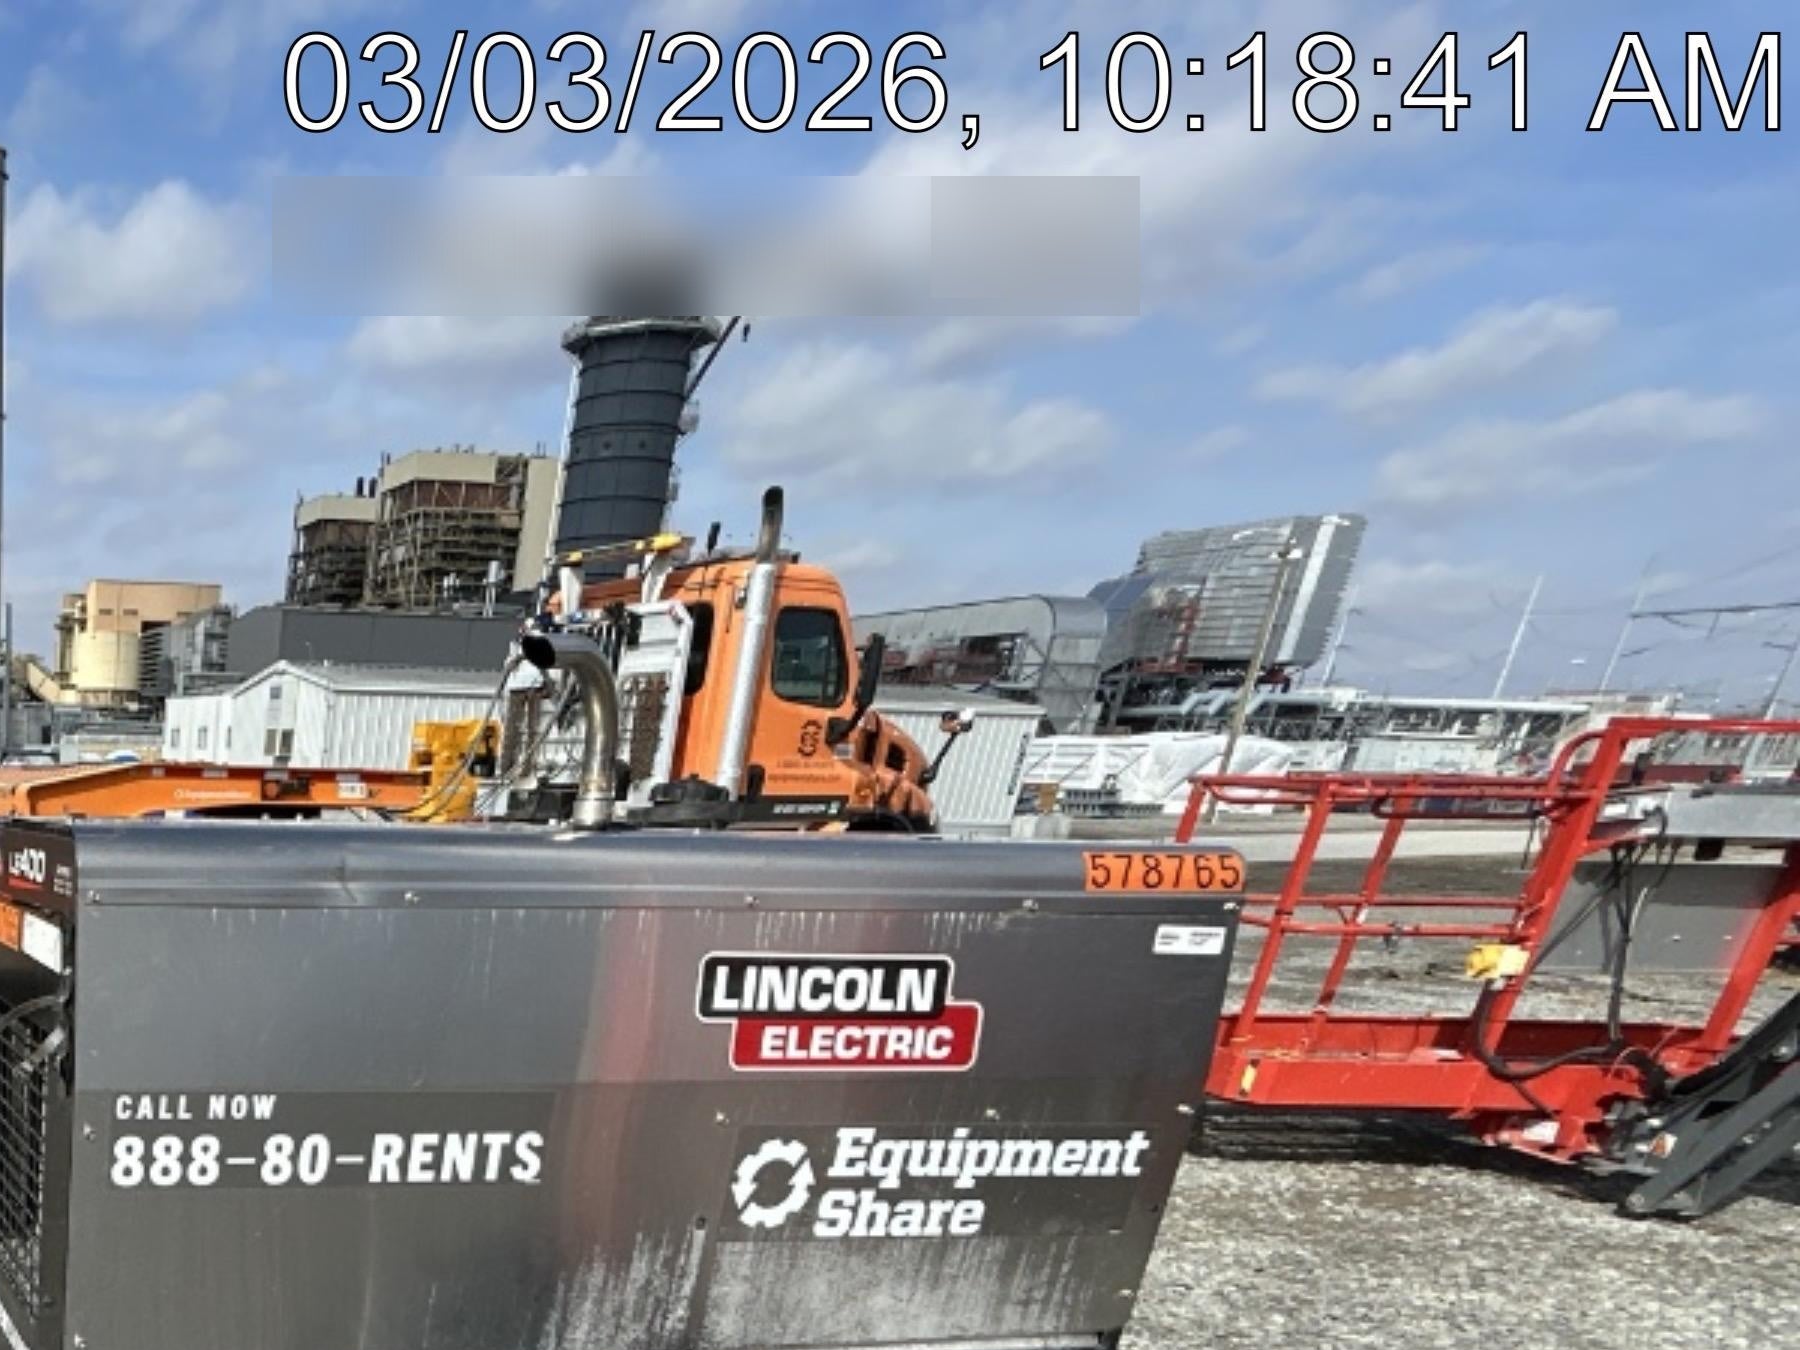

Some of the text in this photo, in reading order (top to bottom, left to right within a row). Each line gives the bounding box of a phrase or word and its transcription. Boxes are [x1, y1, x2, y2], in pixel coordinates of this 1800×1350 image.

[1090, 854, 1240, 889] 578765
[711, 965, 937, 1012] LINCOLN
[760, 1026, 954, 1060] ELECTRIC
[115, 1094, 277, 1120] CALL NOW
[110, 1132, 544, 1187] 888-80-RENTS
[827, 1126, 1150, 1190] Equipment
[812, 1189, 986, 1238] Share
